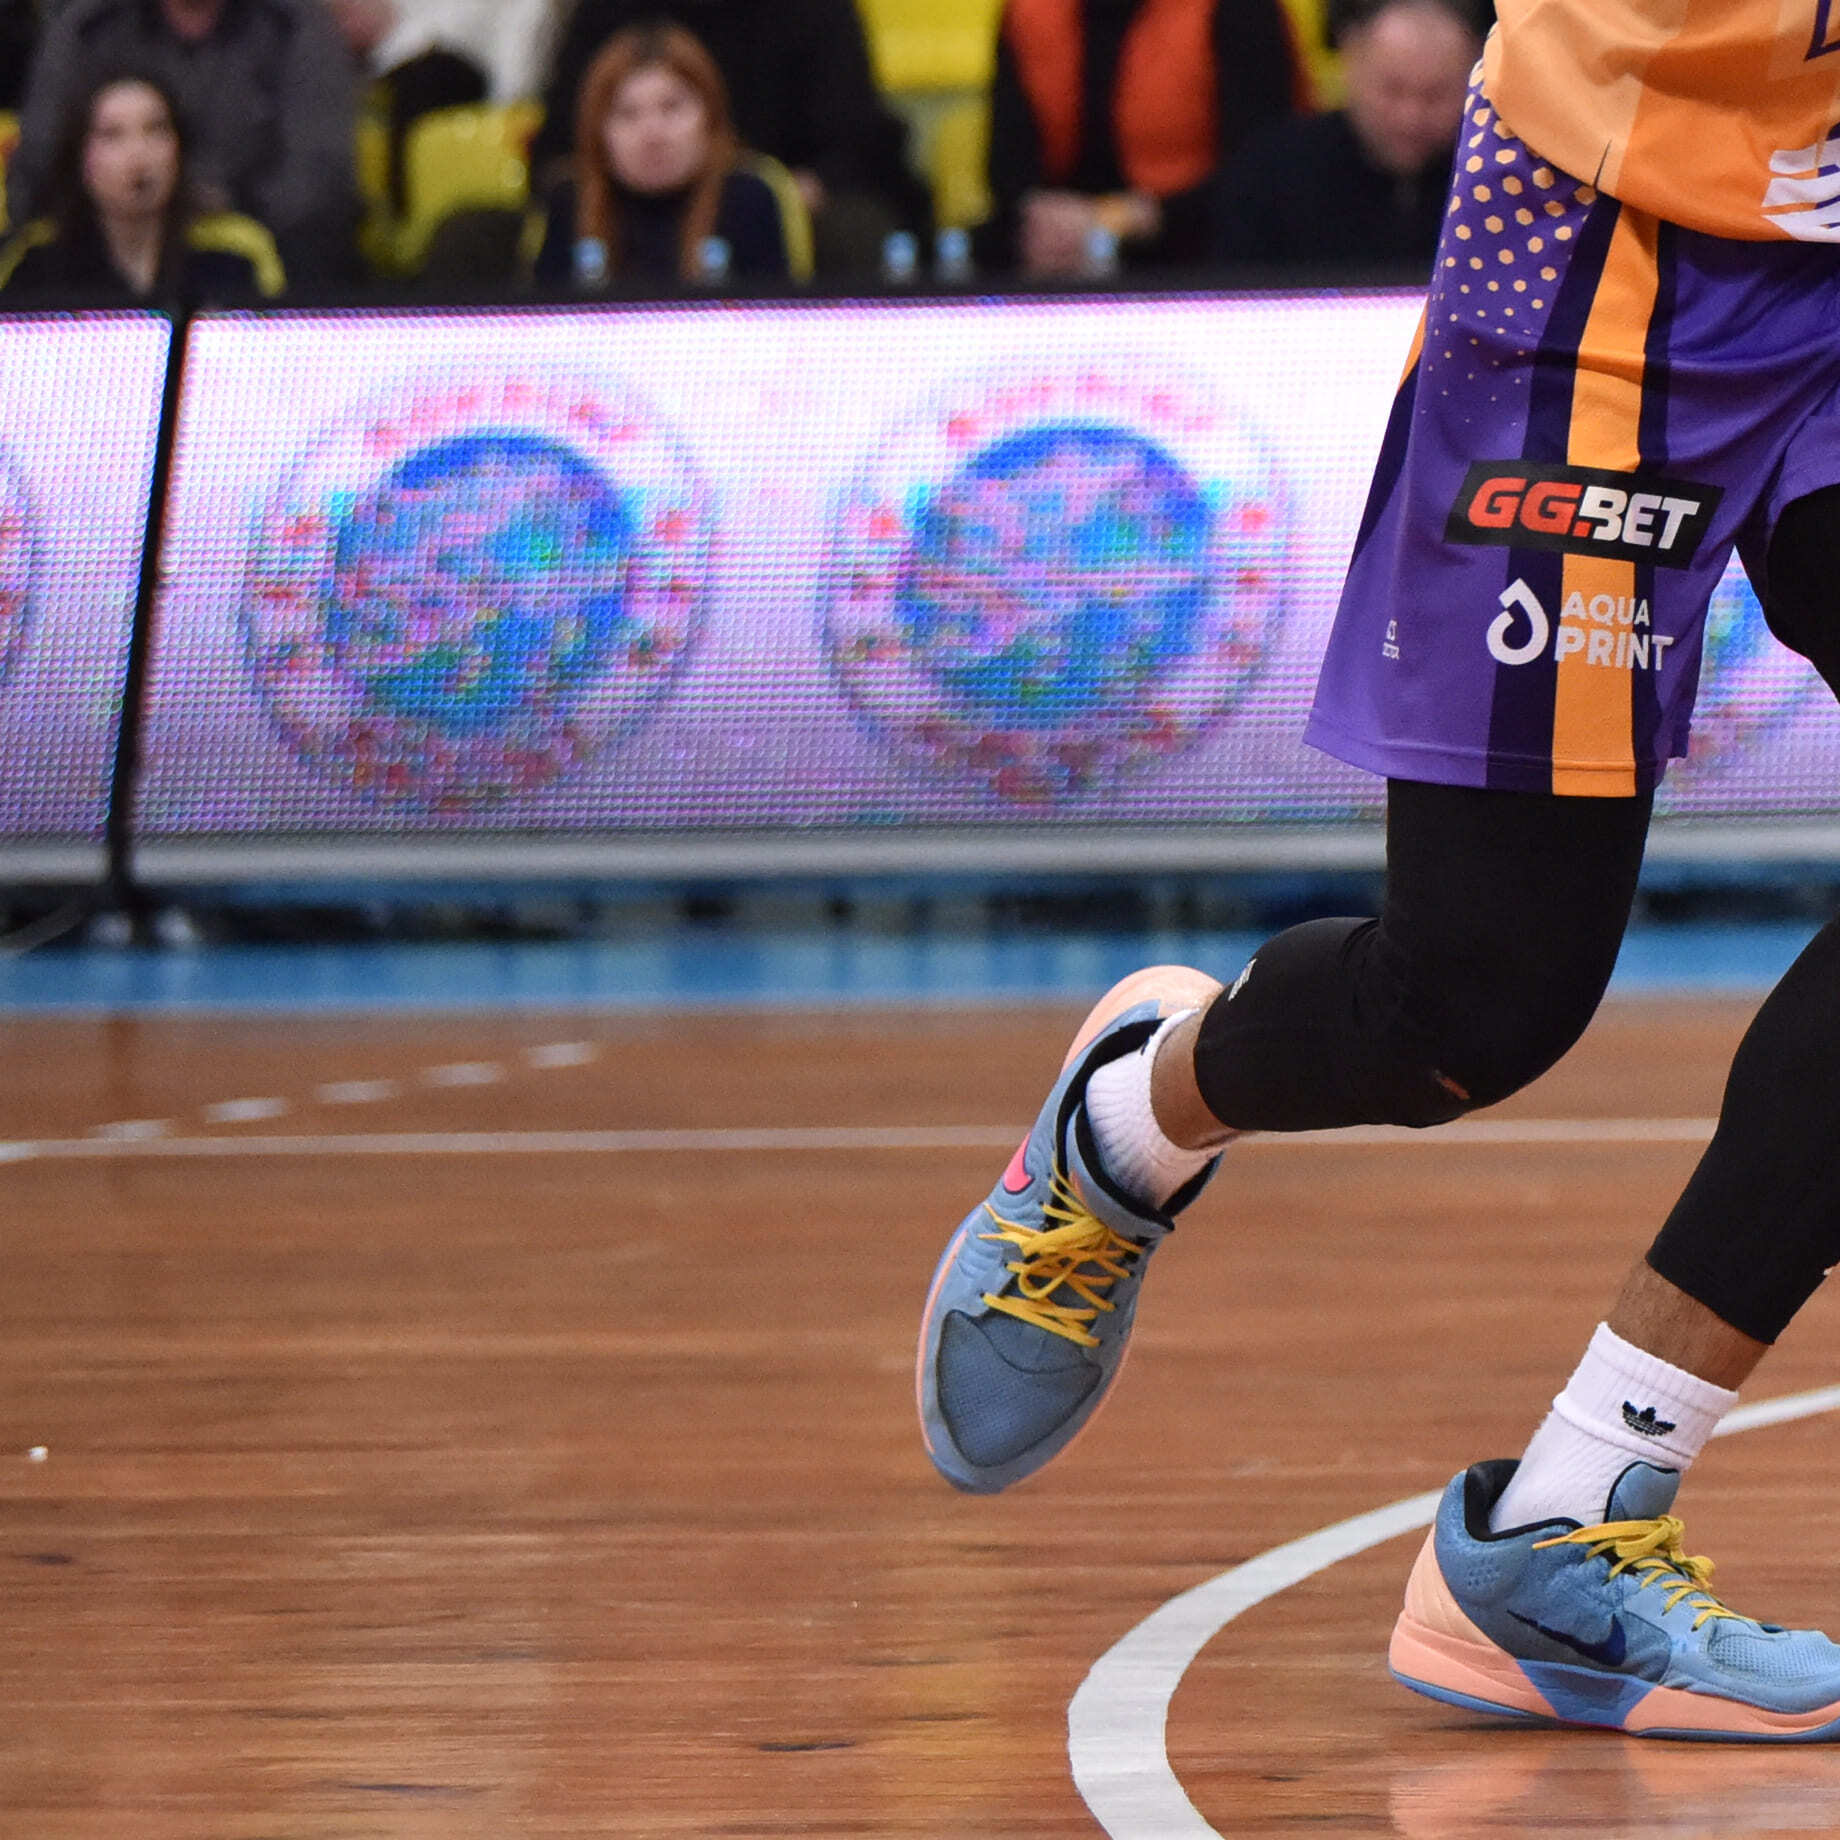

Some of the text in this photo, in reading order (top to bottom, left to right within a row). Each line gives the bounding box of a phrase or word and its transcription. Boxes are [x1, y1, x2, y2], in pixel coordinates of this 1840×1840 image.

[1467, 476, 1701, 550] GG.BET
[1560, 590, 1651, 627] AQUA
[1554, 626, 1675, 671] PRINT
